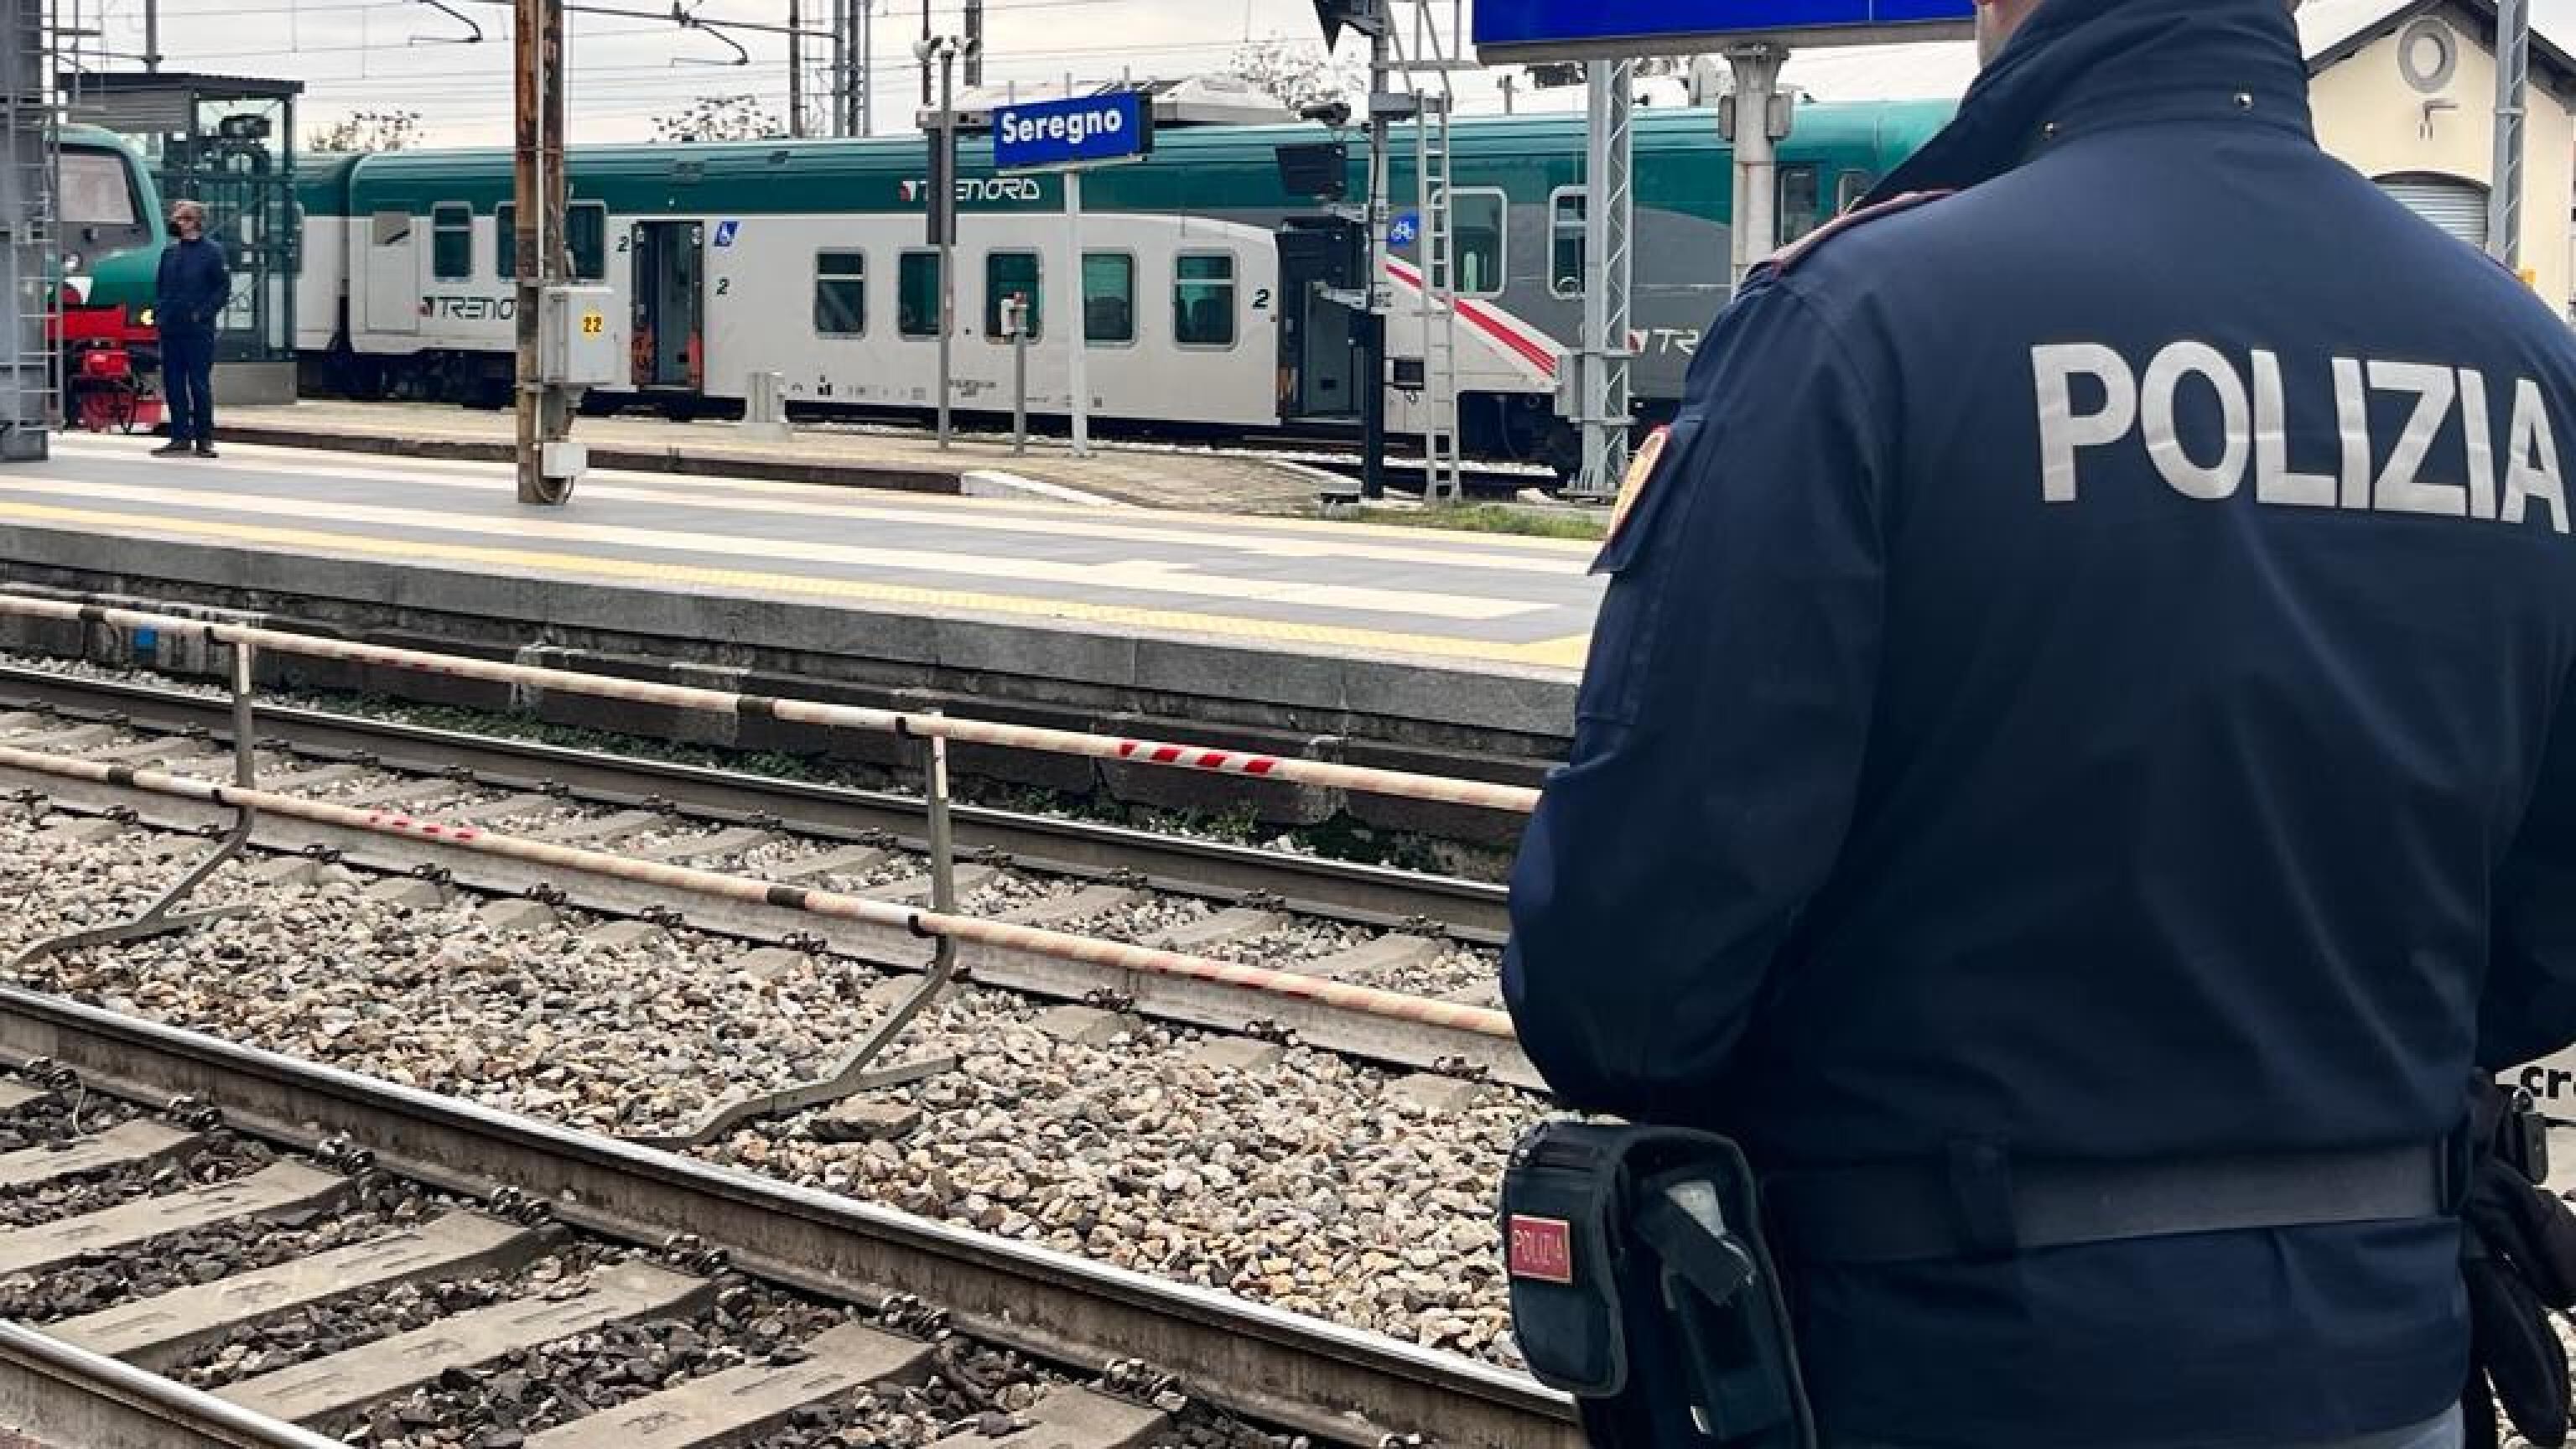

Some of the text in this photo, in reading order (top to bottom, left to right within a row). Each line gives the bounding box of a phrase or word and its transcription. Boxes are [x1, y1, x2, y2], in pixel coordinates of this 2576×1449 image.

[1001, 108, 1122, 143] Seregno
[616, 234, 629, 252] 2
[717, 277, 730, 294] 2
[1252, 288, 1270, 309] 2
[584, 316, 602, 332] 22
[2031, 340, 2571, 533] POLIZIA
[2520, 1066, 2576, 1099] cr
